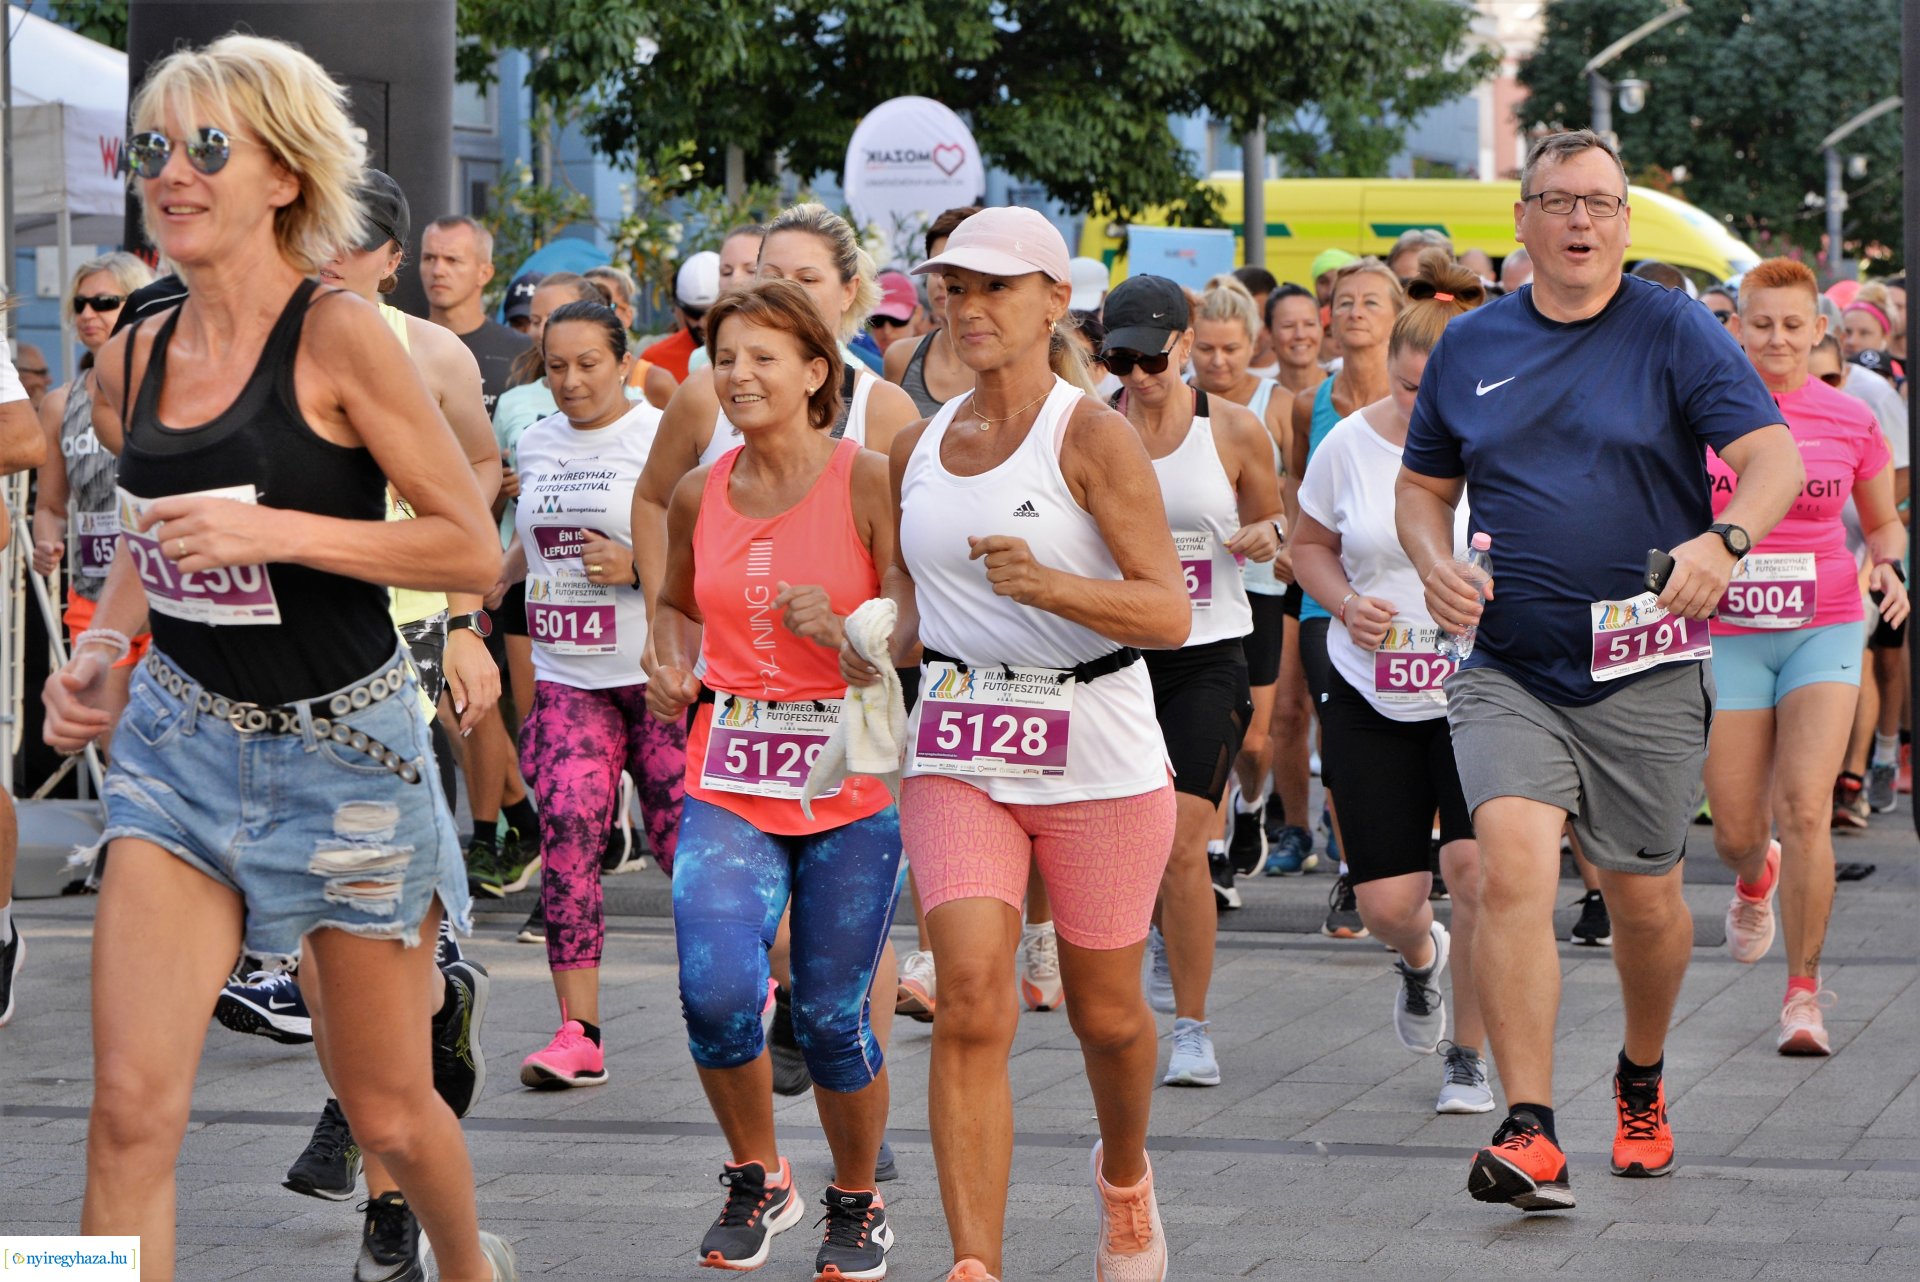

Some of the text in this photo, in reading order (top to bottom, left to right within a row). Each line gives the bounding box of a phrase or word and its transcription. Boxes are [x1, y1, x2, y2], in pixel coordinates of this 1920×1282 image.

[551, 469, 617, 481] NYÍREGYHÁZI
[534, 481, 611, 492] FUTÓFESZTIVÁL
[559, 530, 573, 542] ÉN
[1728, 585, 1804, 614] 5004
[535, 608, 603, 639] 5014
[1608, 616, 1688, 662] 5191
[982, 680, 1062, 697] FUTÓFESZTIVÁL
[766, 711, 839, 723] FUTÓFESZTIVÁL
[936, 710, 1048, 756] 5128
